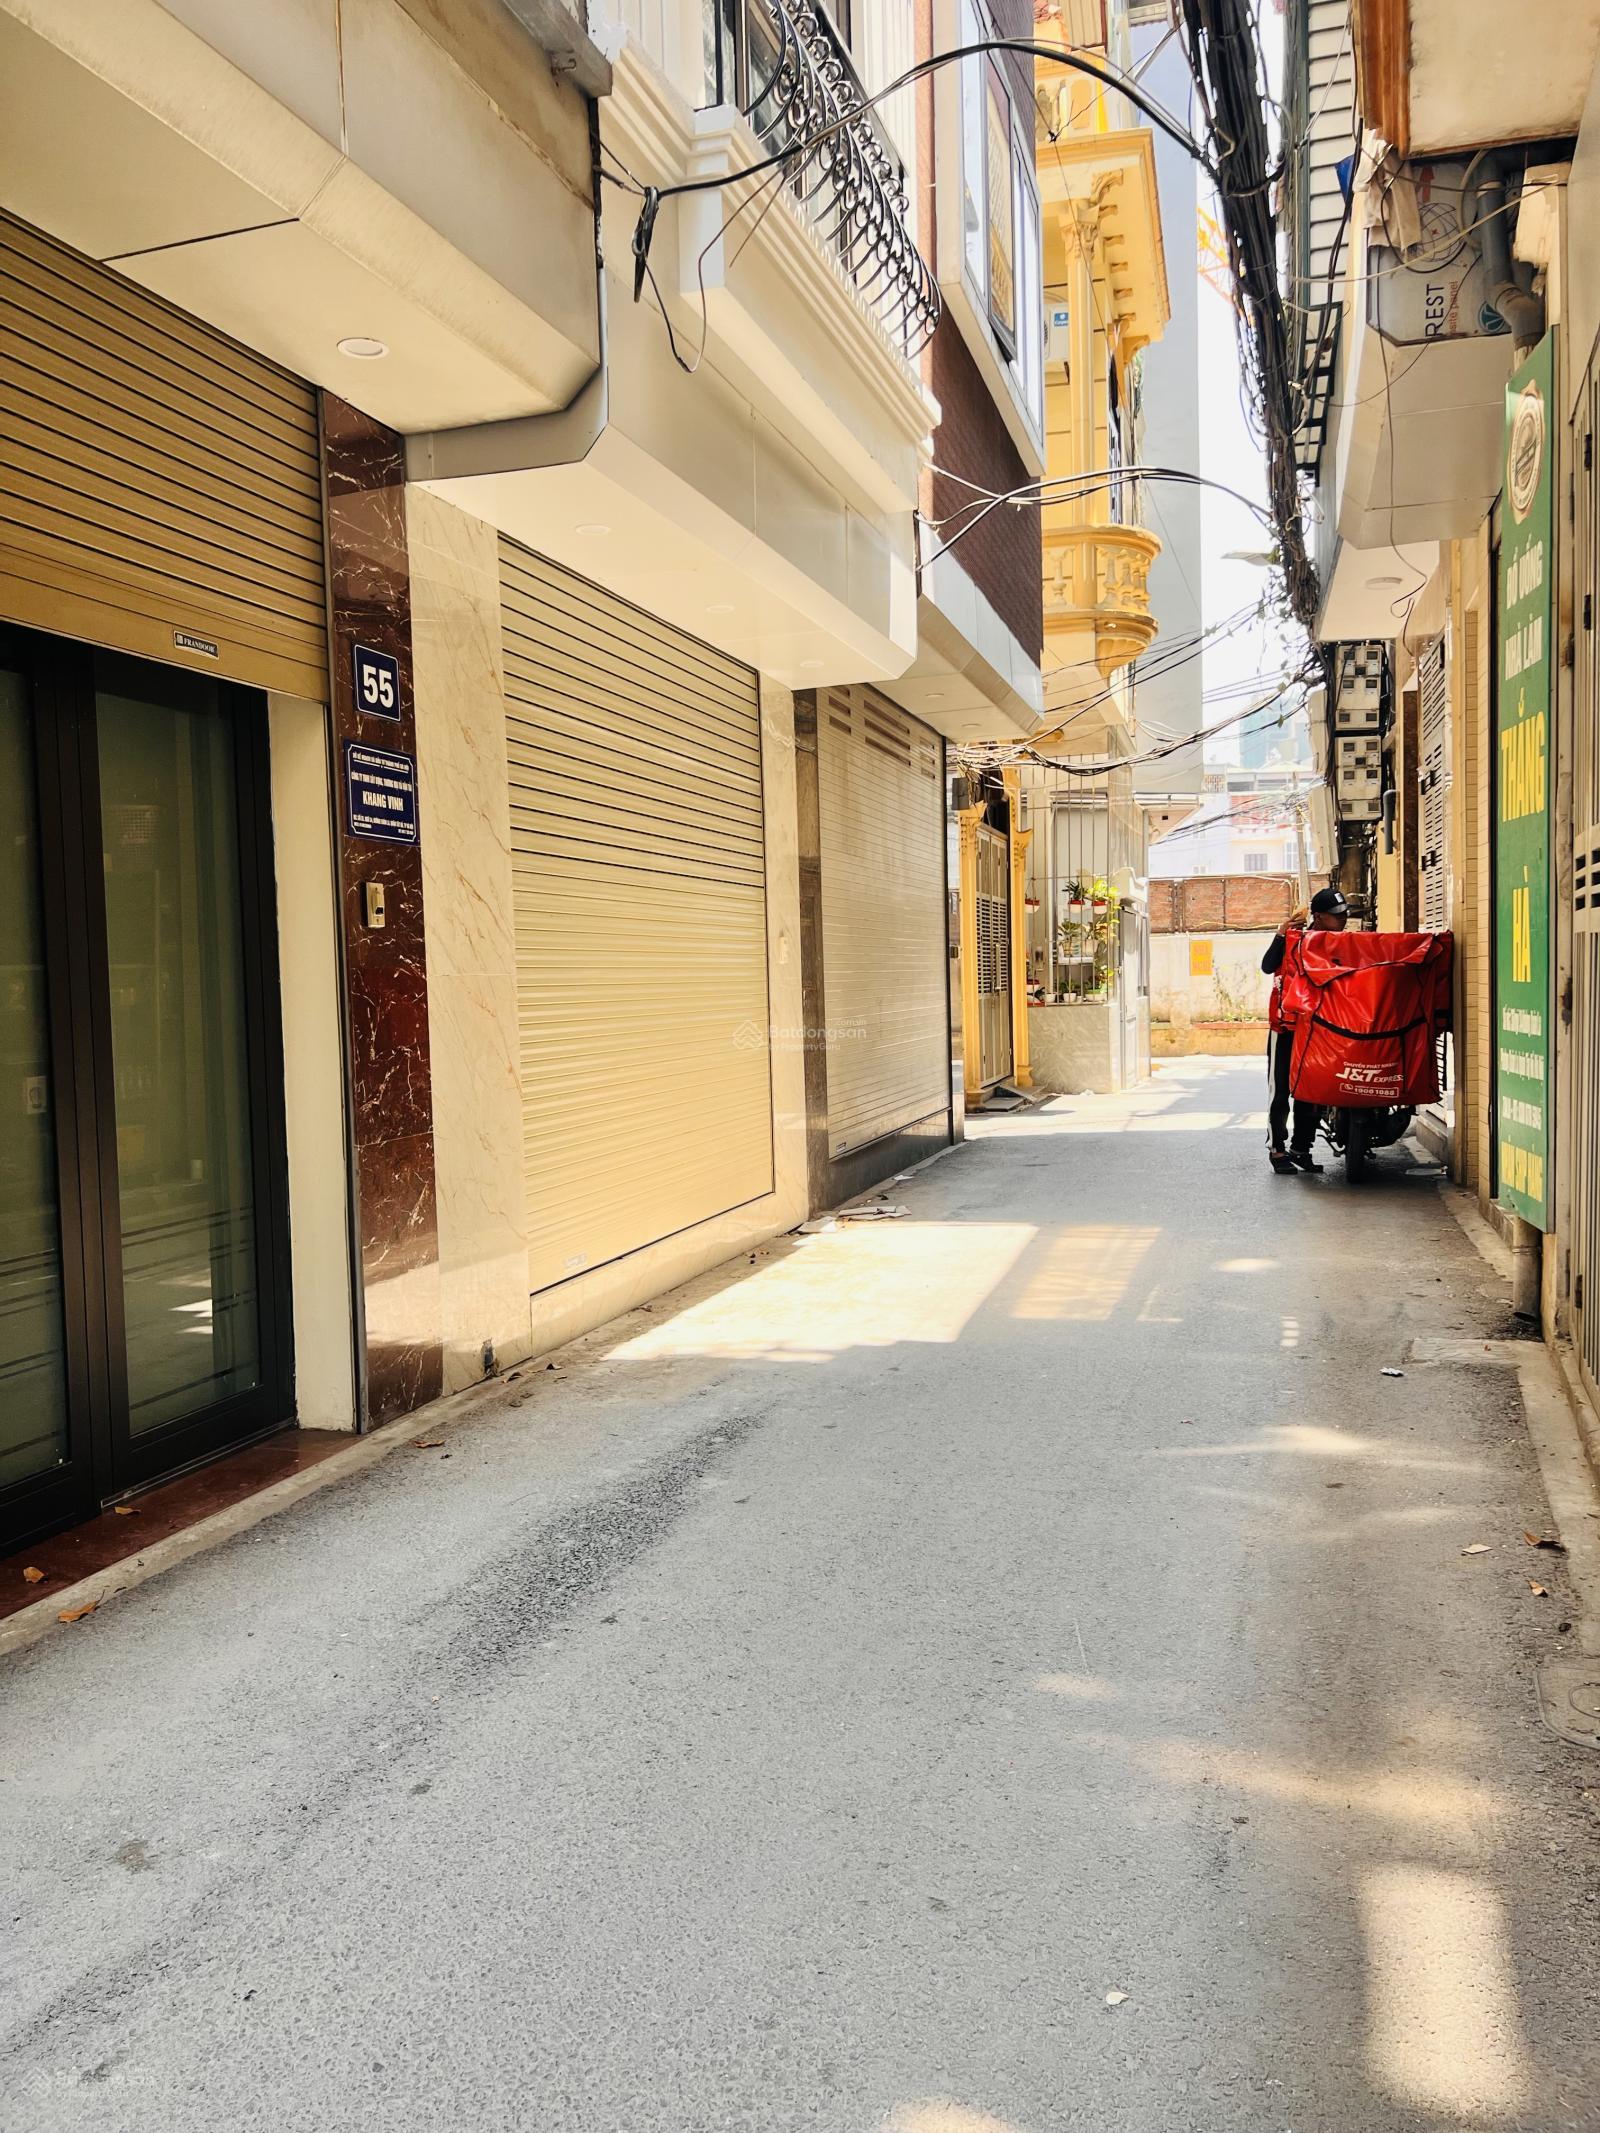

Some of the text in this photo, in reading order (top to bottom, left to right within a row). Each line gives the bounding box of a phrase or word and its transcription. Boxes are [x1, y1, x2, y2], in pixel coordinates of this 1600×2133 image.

[1425, 283, 1445, 337] REST
[363, 664, 394, 708] 55
[1501, 687, 1545, 822] THẮNG
[362, 790, 404, 811] KHANG VINH
[1513, 864, 1531, 982] HÀ
[1335, 1067, 1383, 1083] J&T
